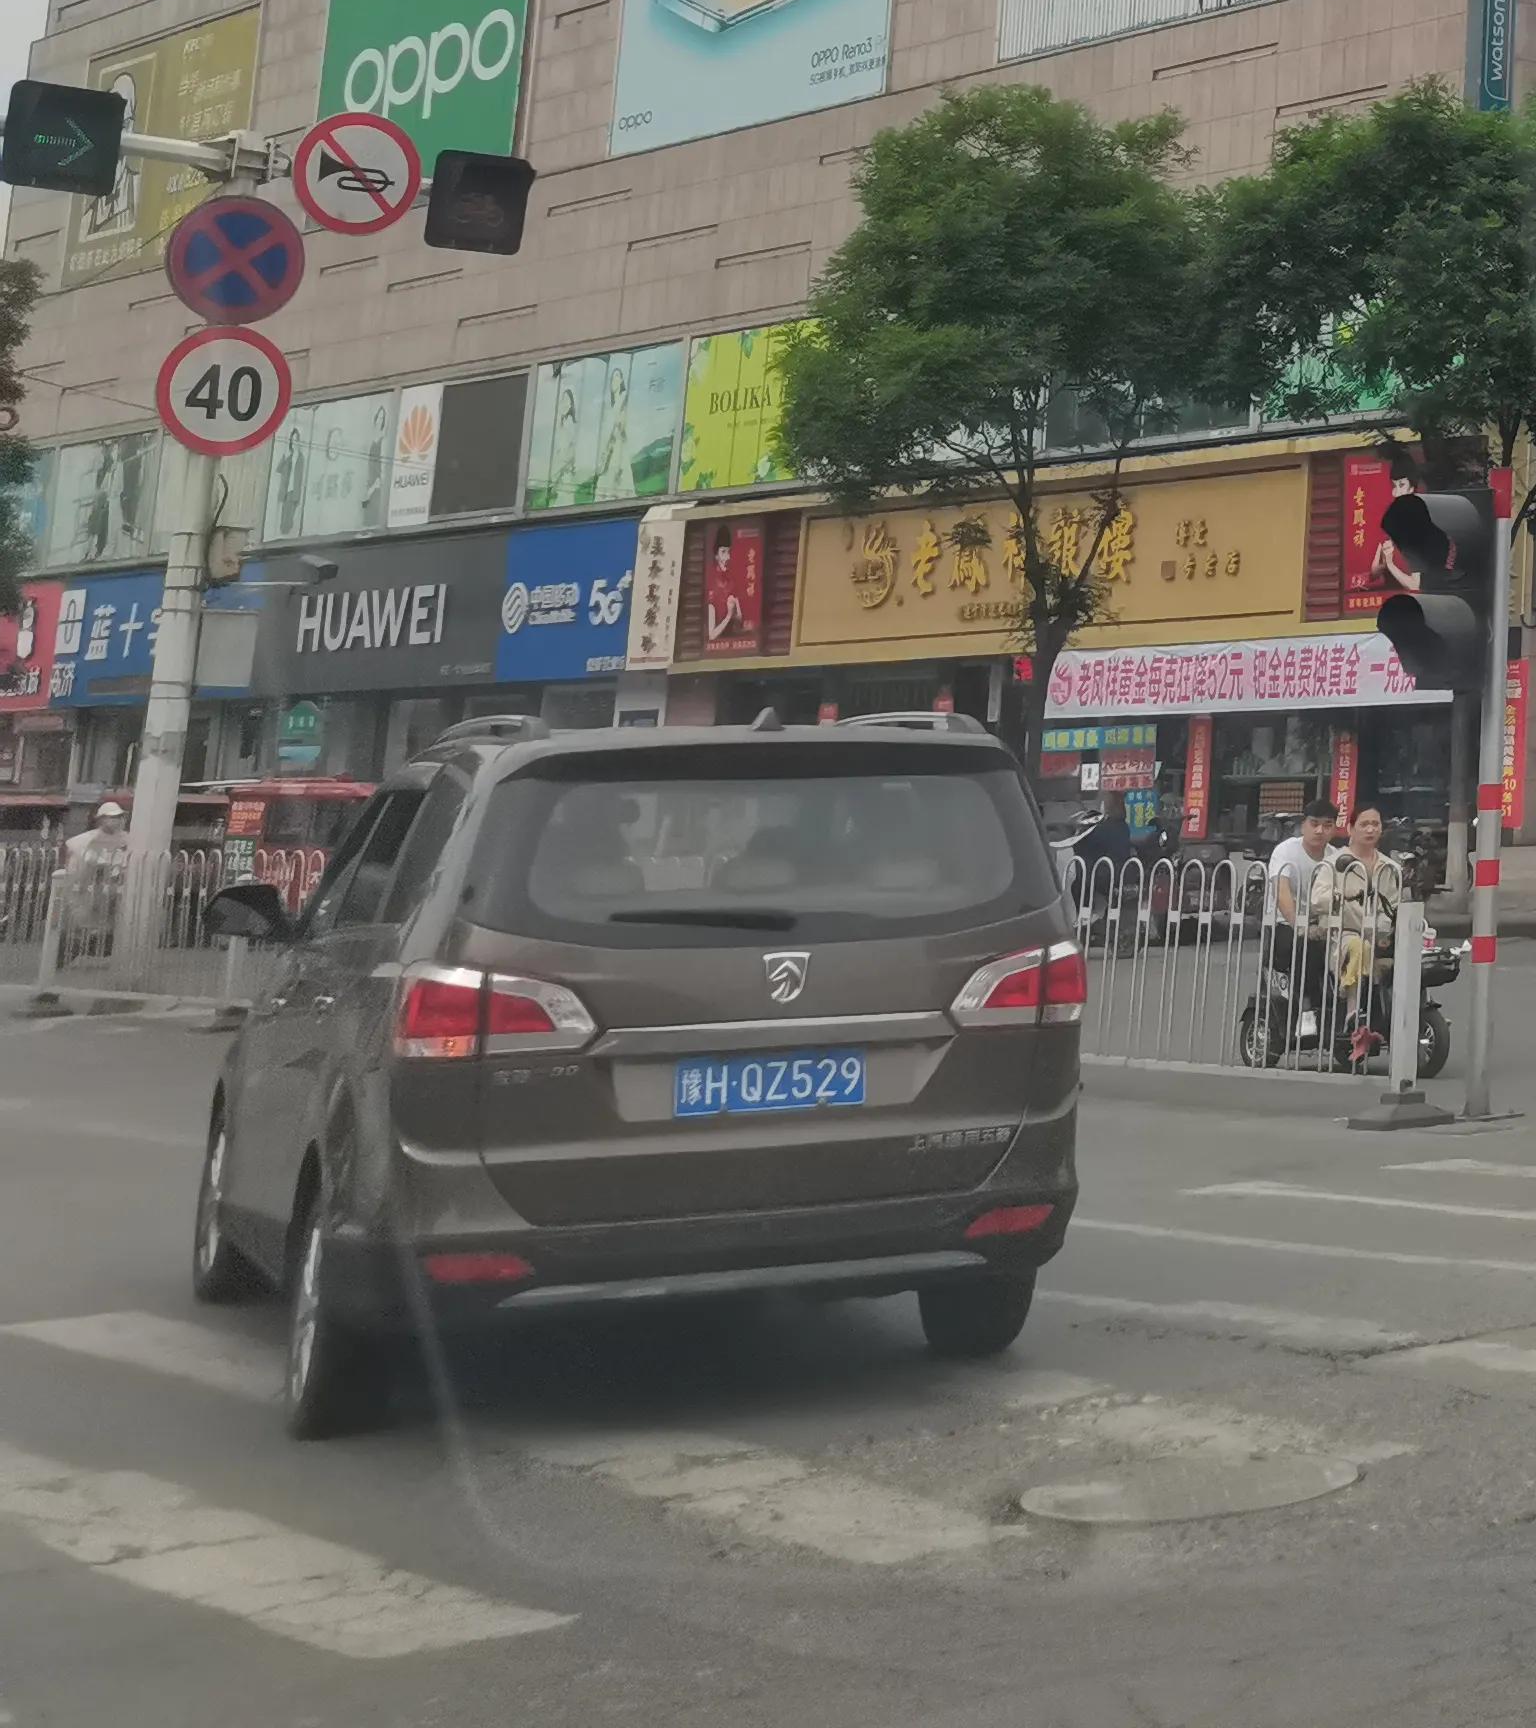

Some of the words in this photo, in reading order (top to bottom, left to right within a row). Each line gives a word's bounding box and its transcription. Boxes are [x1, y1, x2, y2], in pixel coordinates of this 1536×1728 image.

[811, 48, 840, 69] OPPO
[184, 365, 262, 423] 40
[709, 384, 772, 415] BOLIKA
[393, 472, 430, 490] HUAWEI
[530, 582, 580, 610] 中国移动
[296, 583, 448, 654] HUAWEI
